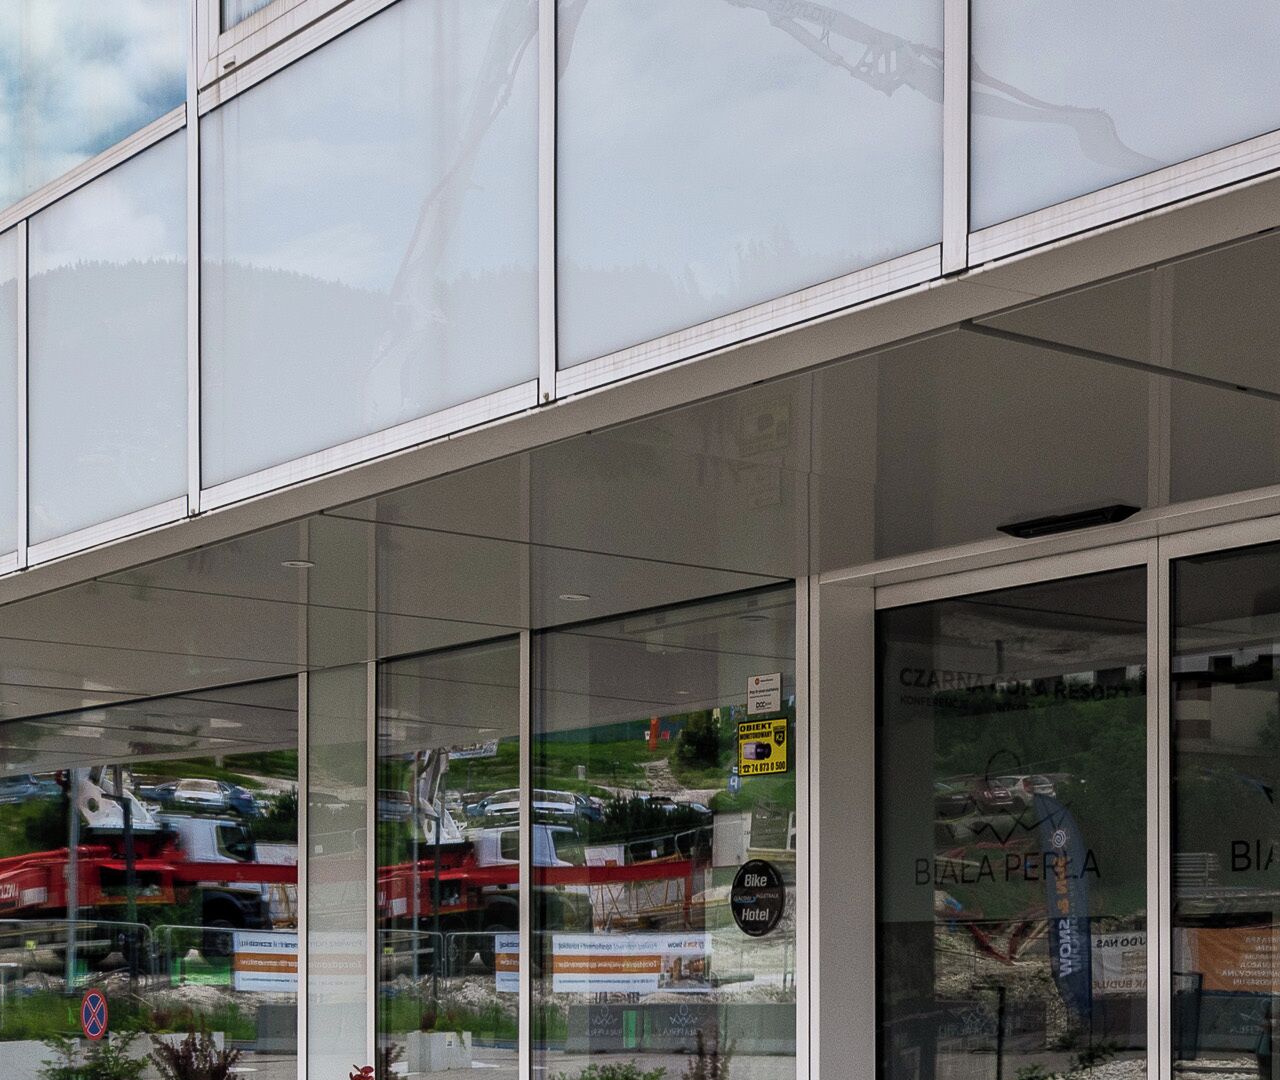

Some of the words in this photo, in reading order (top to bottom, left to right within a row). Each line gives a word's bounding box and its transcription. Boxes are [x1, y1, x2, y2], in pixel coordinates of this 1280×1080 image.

[899, 667, 986, 694] CZARNA
[1052, 679, 1133, 703] RESORT
[739, 722, 773, 732] OBIEKT
[751, 764, 759, 772] 74
[775, 761, 786, 770] 500
[914, 851, 995, 887] BIAŁA
[1005, 848, 1101, 883] PERŁA
[744, 874, 768, 887] Bike
[741, 908, 769, 921] Hotel
